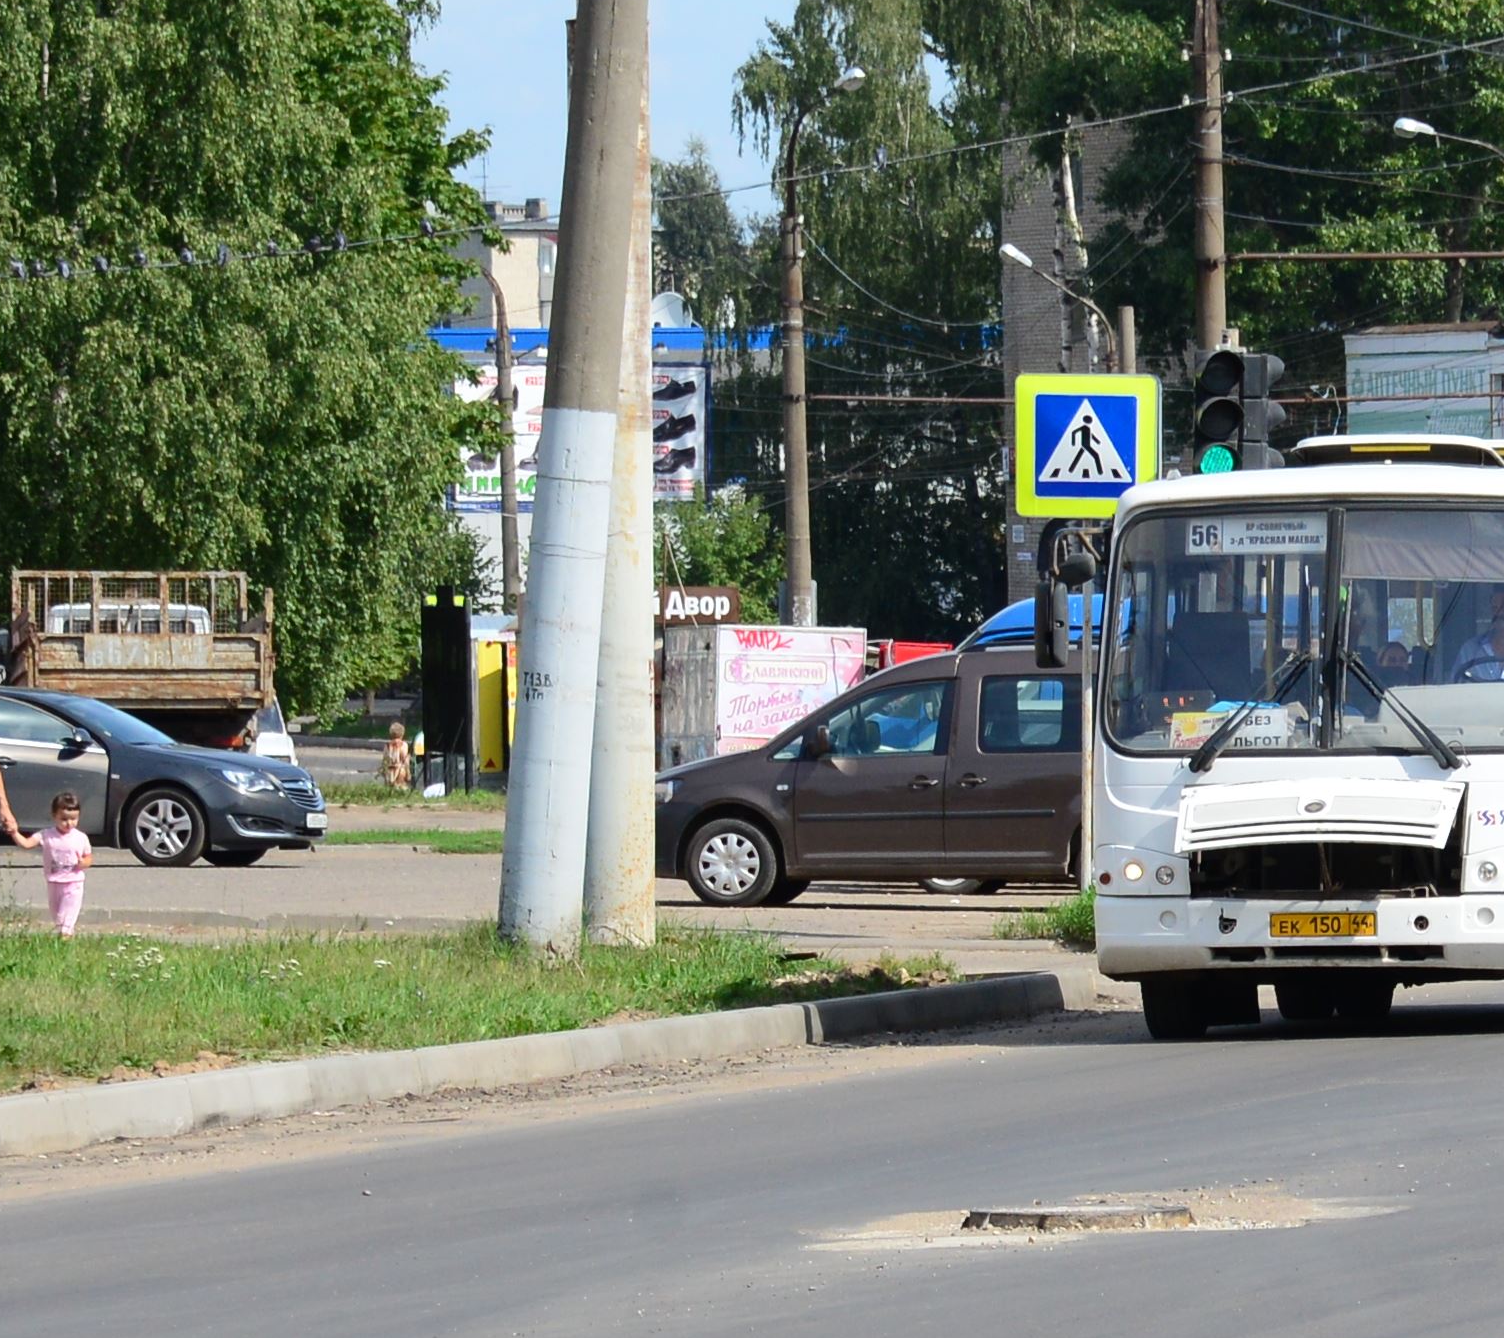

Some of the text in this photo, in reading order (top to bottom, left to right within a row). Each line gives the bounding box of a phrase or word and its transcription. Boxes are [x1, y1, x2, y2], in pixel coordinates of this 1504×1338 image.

[1192, 525, 1218, 547] 56
[665, 591, 730, 620] Двор
[1309, 916, 1342, 934] 150
